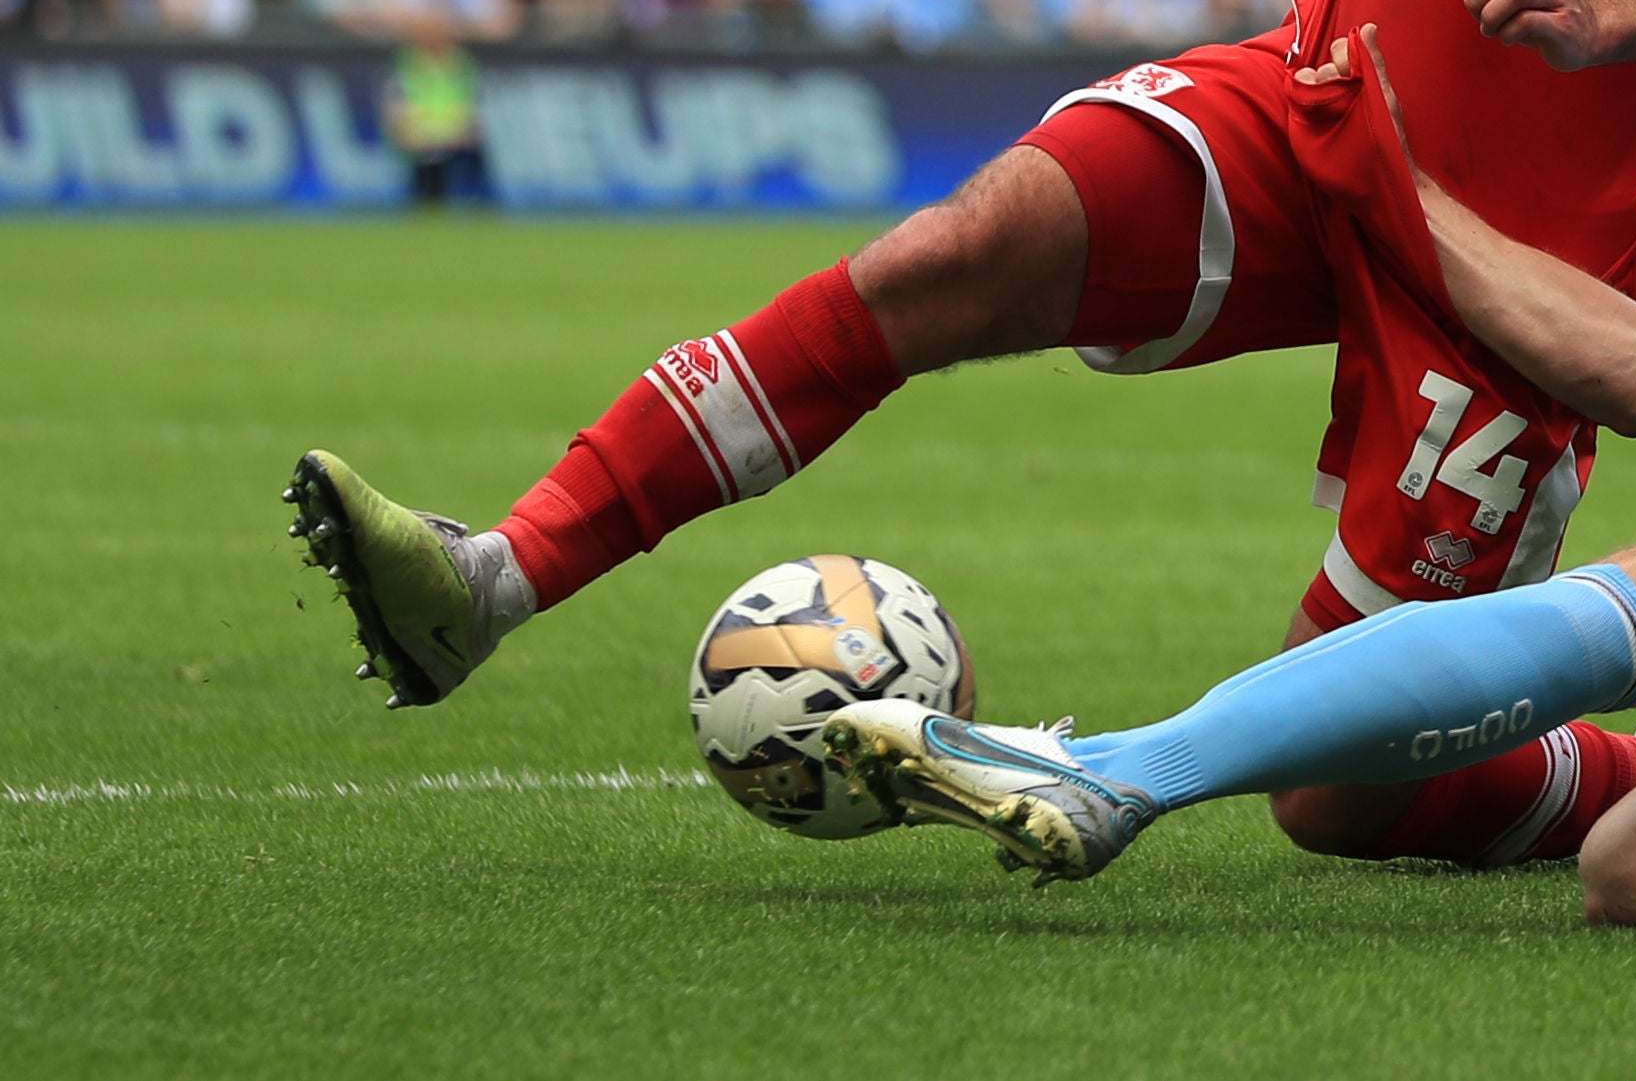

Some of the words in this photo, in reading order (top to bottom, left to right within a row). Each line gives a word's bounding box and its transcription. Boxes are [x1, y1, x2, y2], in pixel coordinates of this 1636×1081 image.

[664, 349, 704, 398] rrea
[1396, 369, 1529, 536] 14
[1411, 558, 1468, 594] errea
